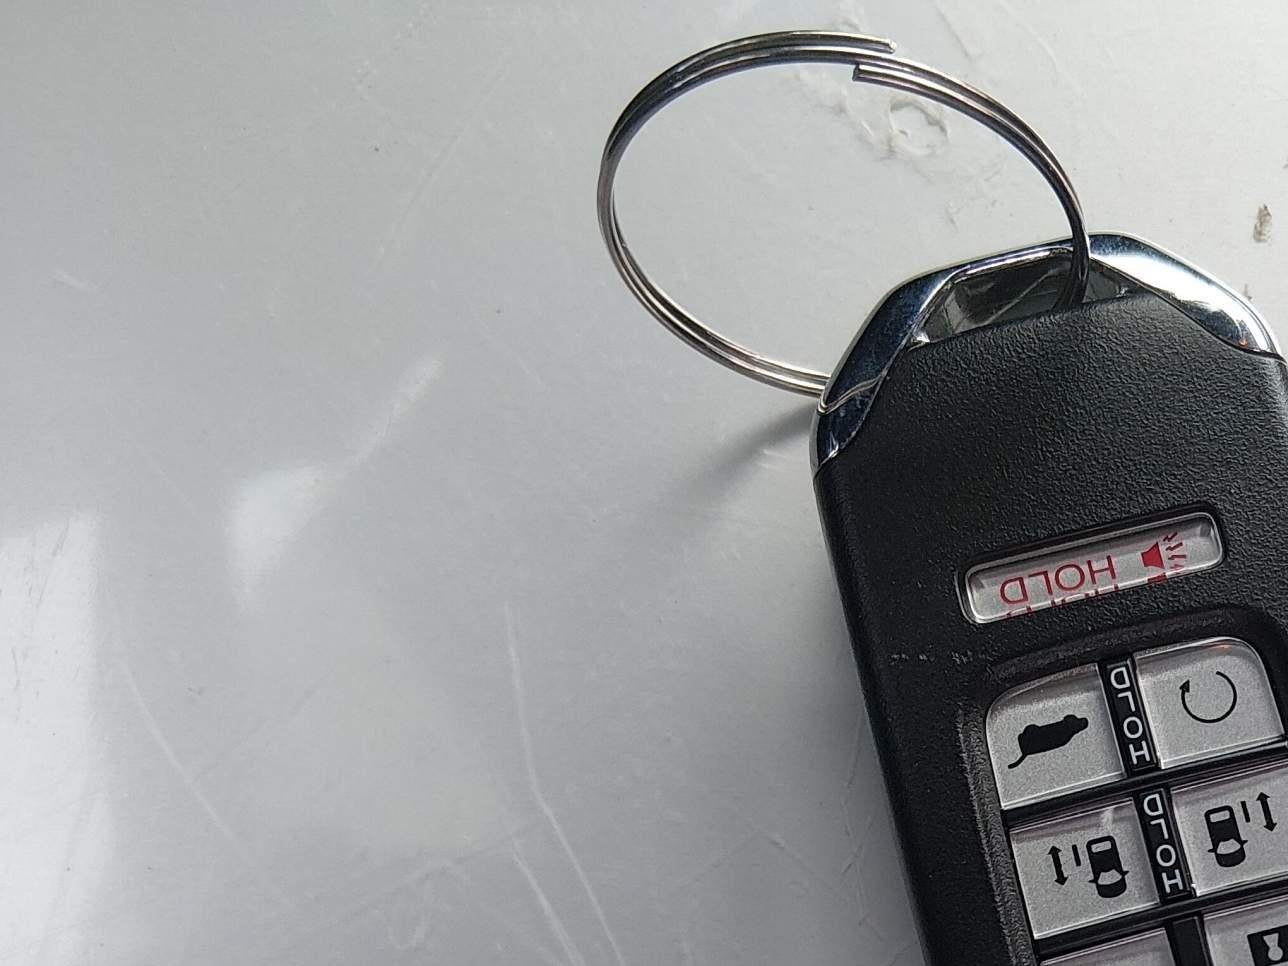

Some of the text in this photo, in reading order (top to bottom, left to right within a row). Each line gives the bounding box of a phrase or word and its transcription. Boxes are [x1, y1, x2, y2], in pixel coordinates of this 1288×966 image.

[999, 554, 1118, 605] HOLD
[1110, 666, 1151, 765] HOLD
[1143, 793, 1184, 894] HOLD
